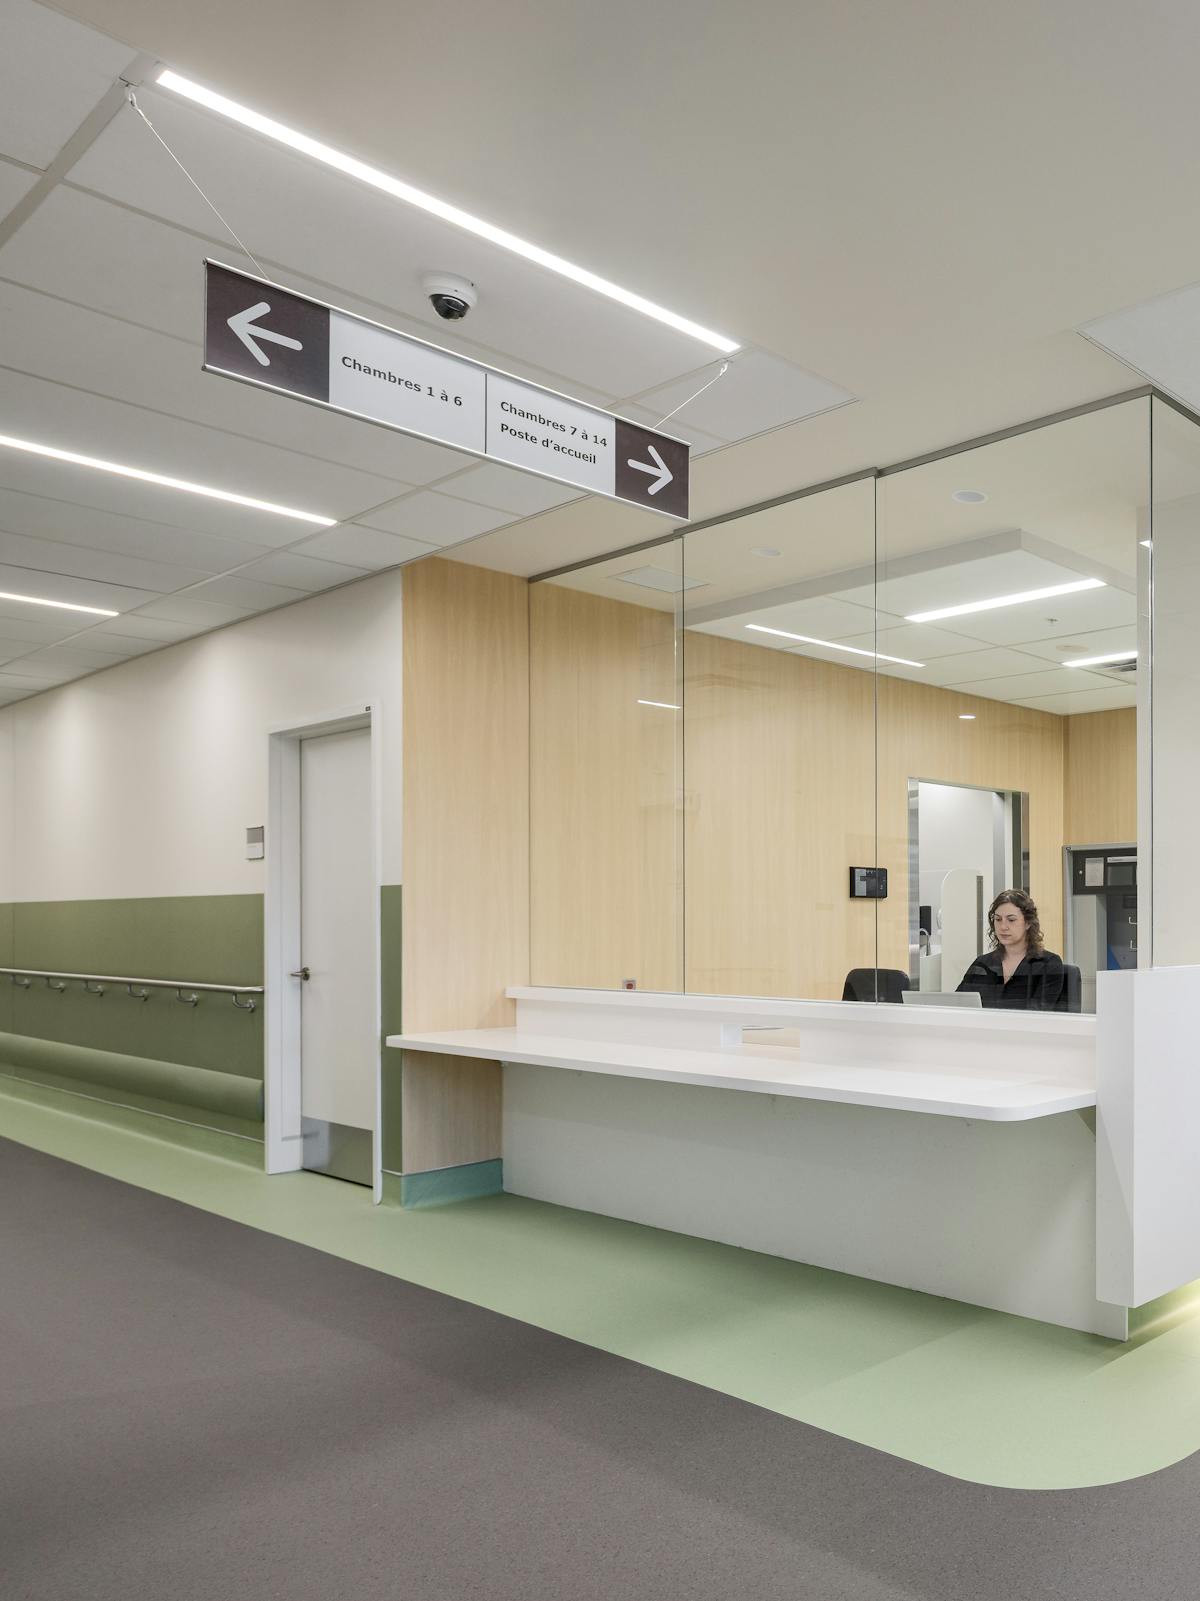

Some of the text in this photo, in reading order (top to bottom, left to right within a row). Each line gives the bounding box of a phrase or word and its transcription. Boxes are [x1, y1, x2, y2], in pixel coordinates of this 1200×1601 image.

[341, 356, 463, 407] Chambres 1 à 6
[500, 401, 607, 447] Chambres 7 à 14
[500, 423, 596, 464] Poste d’accueil
